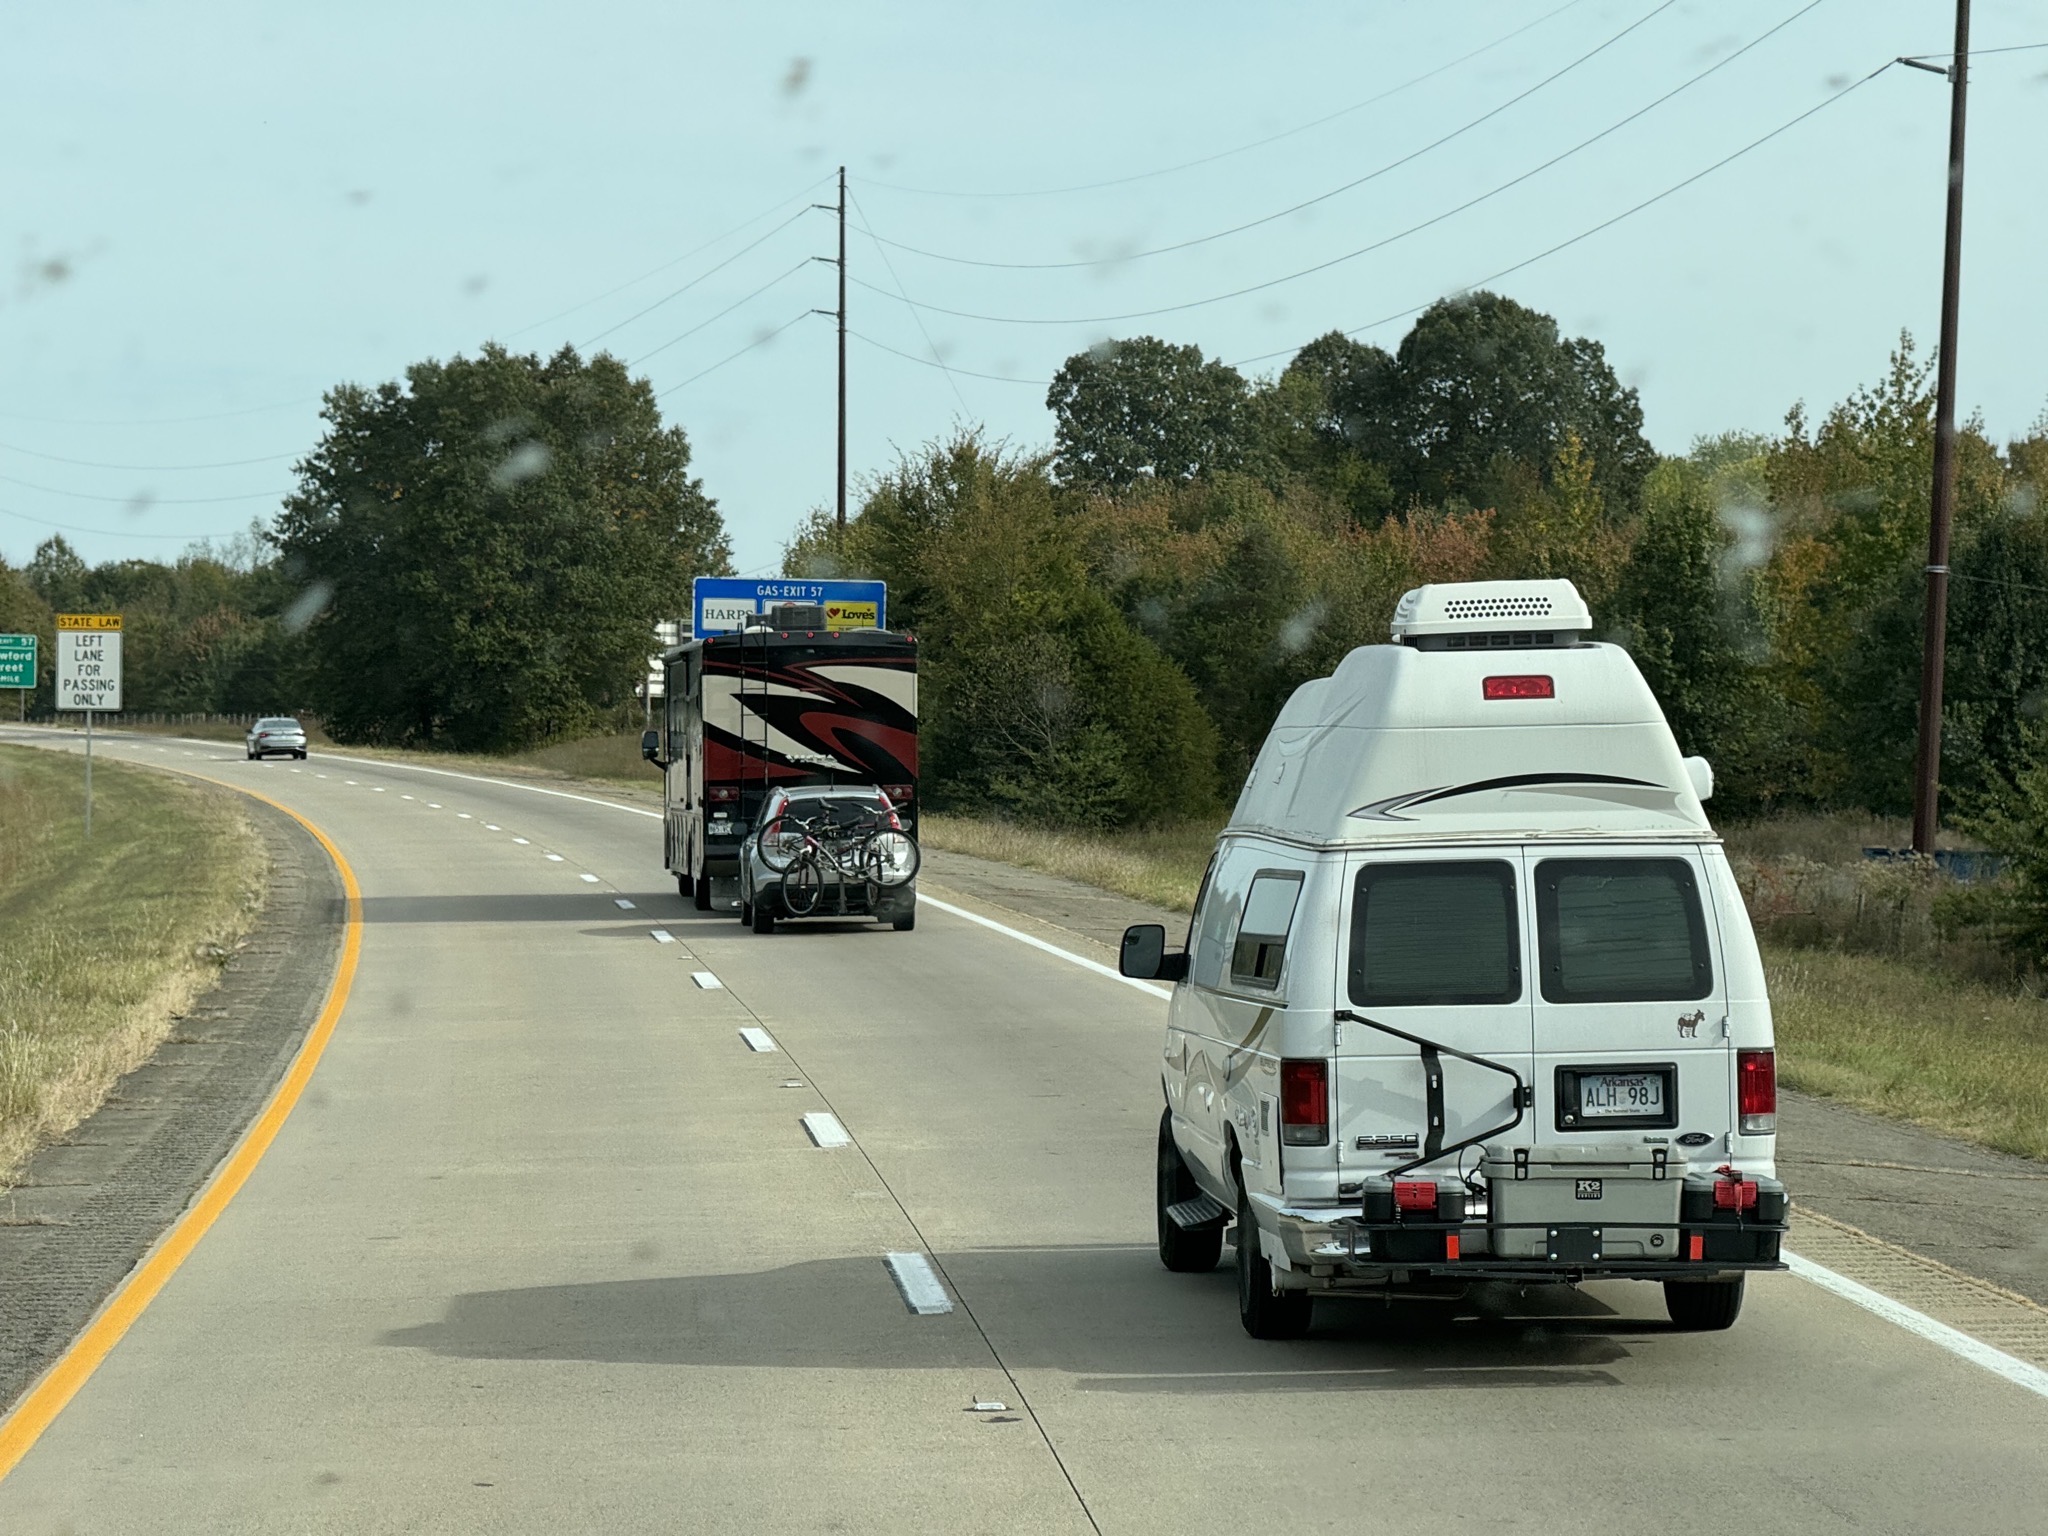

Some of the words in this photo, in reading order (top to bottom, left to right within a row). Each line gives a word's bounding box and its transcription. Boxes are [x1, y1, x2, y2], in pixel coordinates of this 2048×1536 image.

[757, 585, 807, 597] GAS-EXIT
[811, 587, 823, 597] 57
[60, 618, 92, 627] STATE
[99, 618, 120, 627] LAW
[76, 635, 103, 647] LEFT
[74, 650, 104, 662] LANE
[78, 664, 101, 676] FOR
[63, 679, 115, 691] PASSING
[73, 693, 105, 706] ONLY
[1600, 1076, 1645, 1088] Arkansas
[1586, 1087, 1617, 1107] ALH
[1628, 1086, 1660, 1106] 98J
[1685, 1134, 1706, 1144] Ford
[1577, 1180, 1601, 1192] K2
